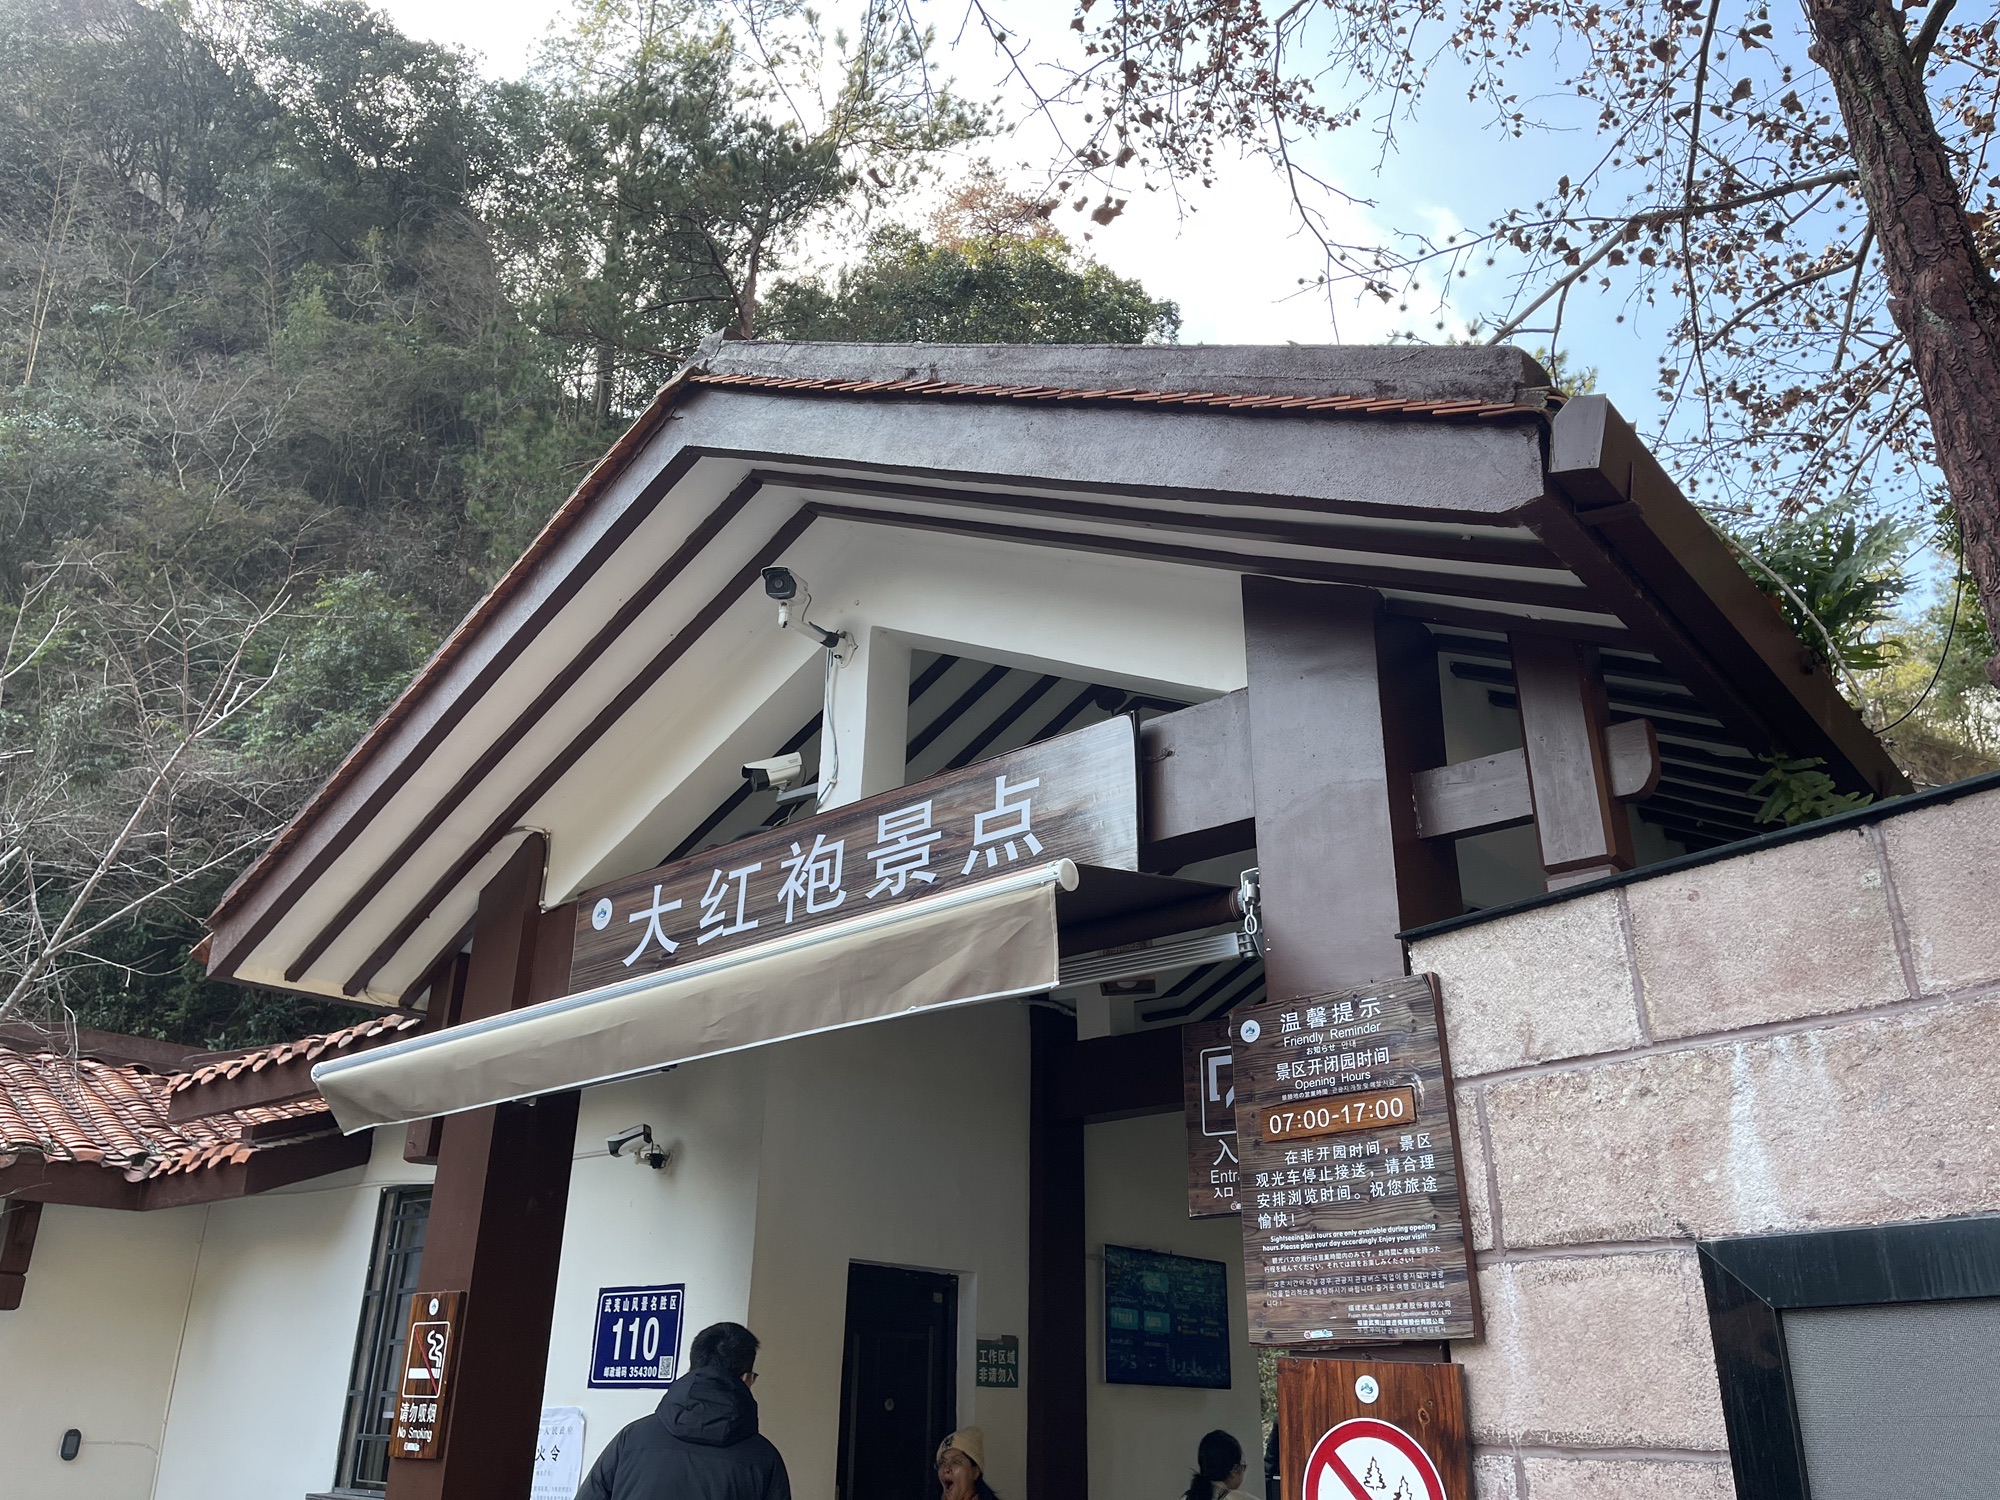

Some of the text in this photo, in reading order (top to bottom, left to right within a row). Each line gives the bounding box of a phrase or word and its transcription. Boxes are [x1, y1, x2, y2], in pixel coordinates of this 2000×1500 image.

[622, 774, 1044, 967] 大红袍景点
[1280, 997, 1381, 1033] 温馨提示
[1283, 1022, 1381, 1048] Friendly Reminder
[1306, 1043, 1336, 1056] お知らせ
[1276, 1047, 1390, 1081] 景区开闭园时间
[1294, 1071, 1371, 1090] Opening Hours
[1269, 1097, 1403, 1134] 07:00-17:00
[1210, 1169, 1240, 1184] Entr
[1214, 1187, 1234, 1198] 入口
[1270, 1233, 1304, 1243] Sightseeing
[1305, 1232, 1316, 1240] bus
[1317, 1231, 1332, 1239] tours
[1344, 1229, 1357, 1238] only
[1358, 1226, 1386, 1236] available
[1388, 1225, 1408, 1234] during
[1409, 1222, 1436, 1232] opening
[1301, 1241, 1314, 1250] plan
[1315, 1240, 1328, 1249] your
[1329, 1239, 1340, 1248] day
[1396, 1234, 1411, 1243] your
[603, 1295, 677, 1313] 武夷山风景名胜区
[612, 1316, 660, 1361] 110
[978, 1349, 1016, 1365] 工作区域
[628, 1366, 657, 1378] 354300
[978, 1367, 1016, 1382] 非请勿入
[400, 1402, 438, 1423] 请勿吸烟
[397, 1426, 432, 1442] No Smoking
[540, 1425, 574, 1436] 人民政府
